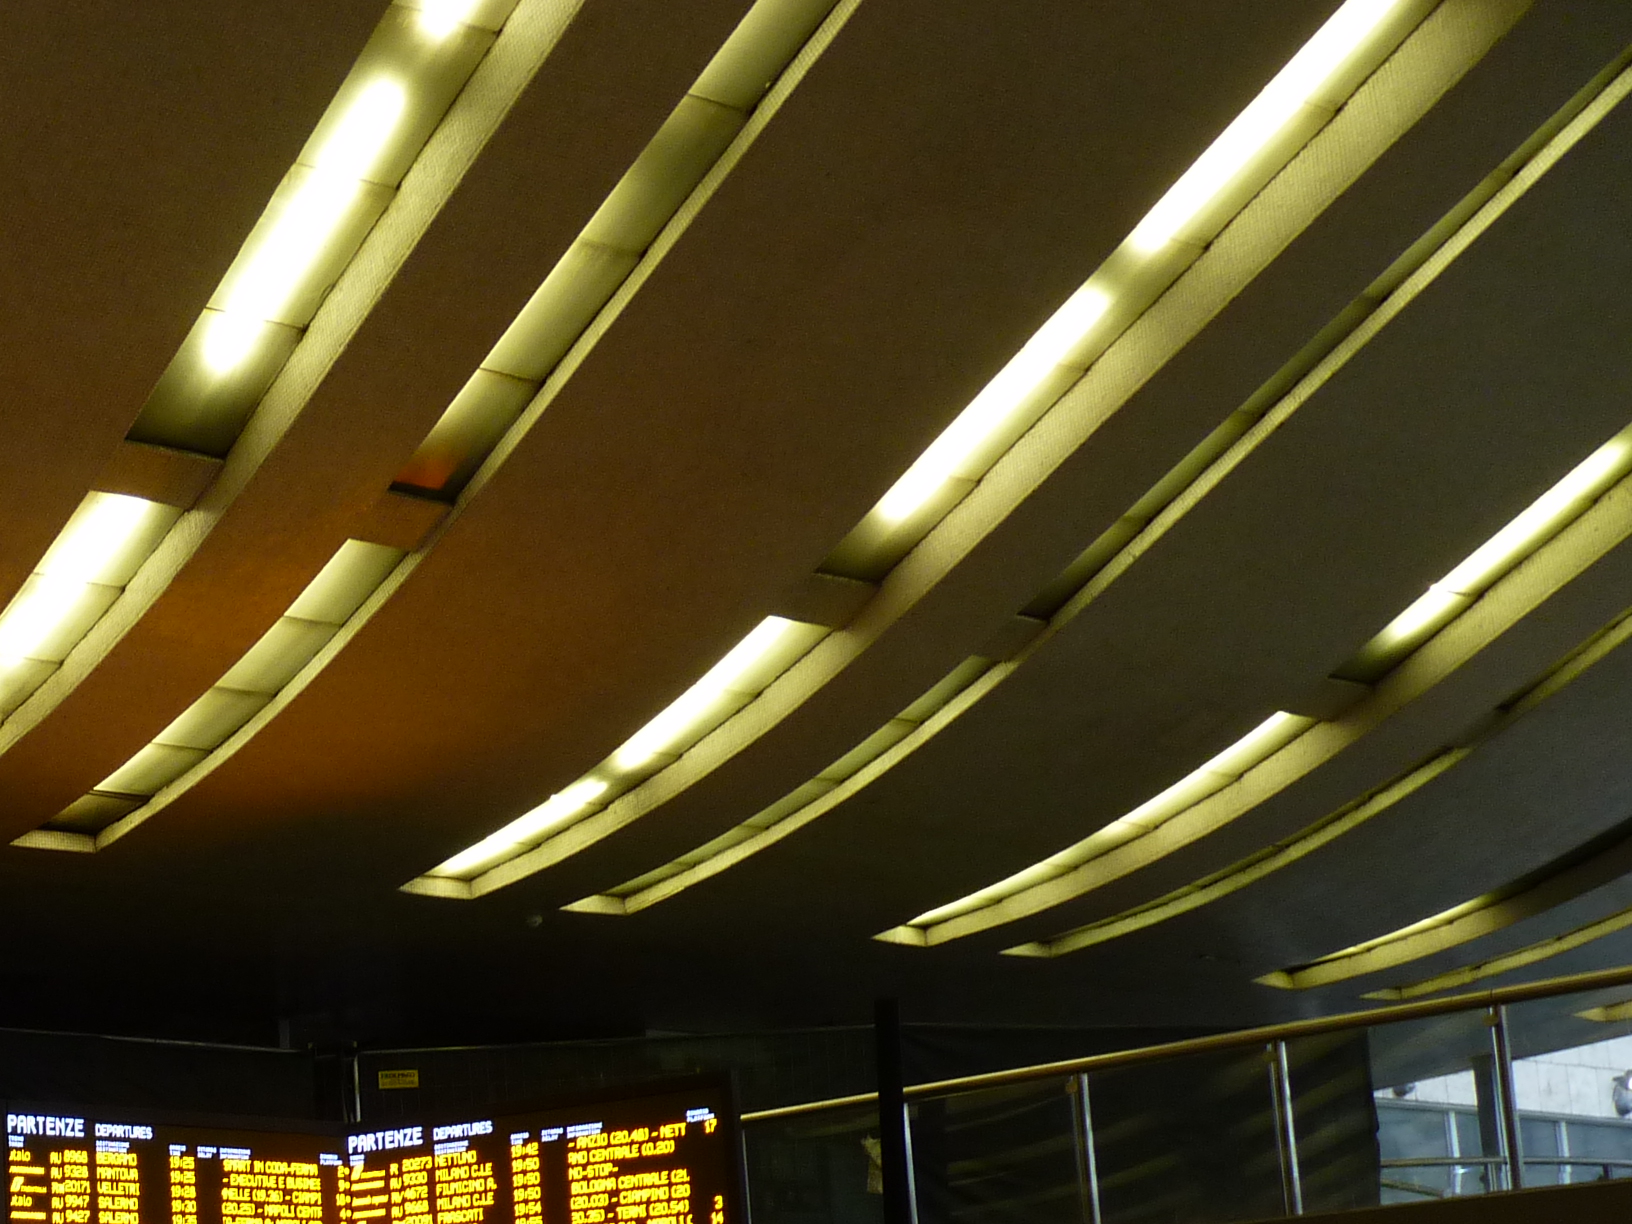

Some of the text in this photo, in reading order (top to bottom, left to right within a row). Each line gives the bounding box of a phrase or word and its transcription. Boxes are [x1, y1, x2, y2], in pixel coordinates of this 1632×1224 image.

[7, 1114, 84, 1137] PARTENZE
[95, 1123, 153, 1139] DEPARTURES
[433, 1120, 493, 1141] DEPARTURES
[348, 1126, 423, 1154] PARTENZE
